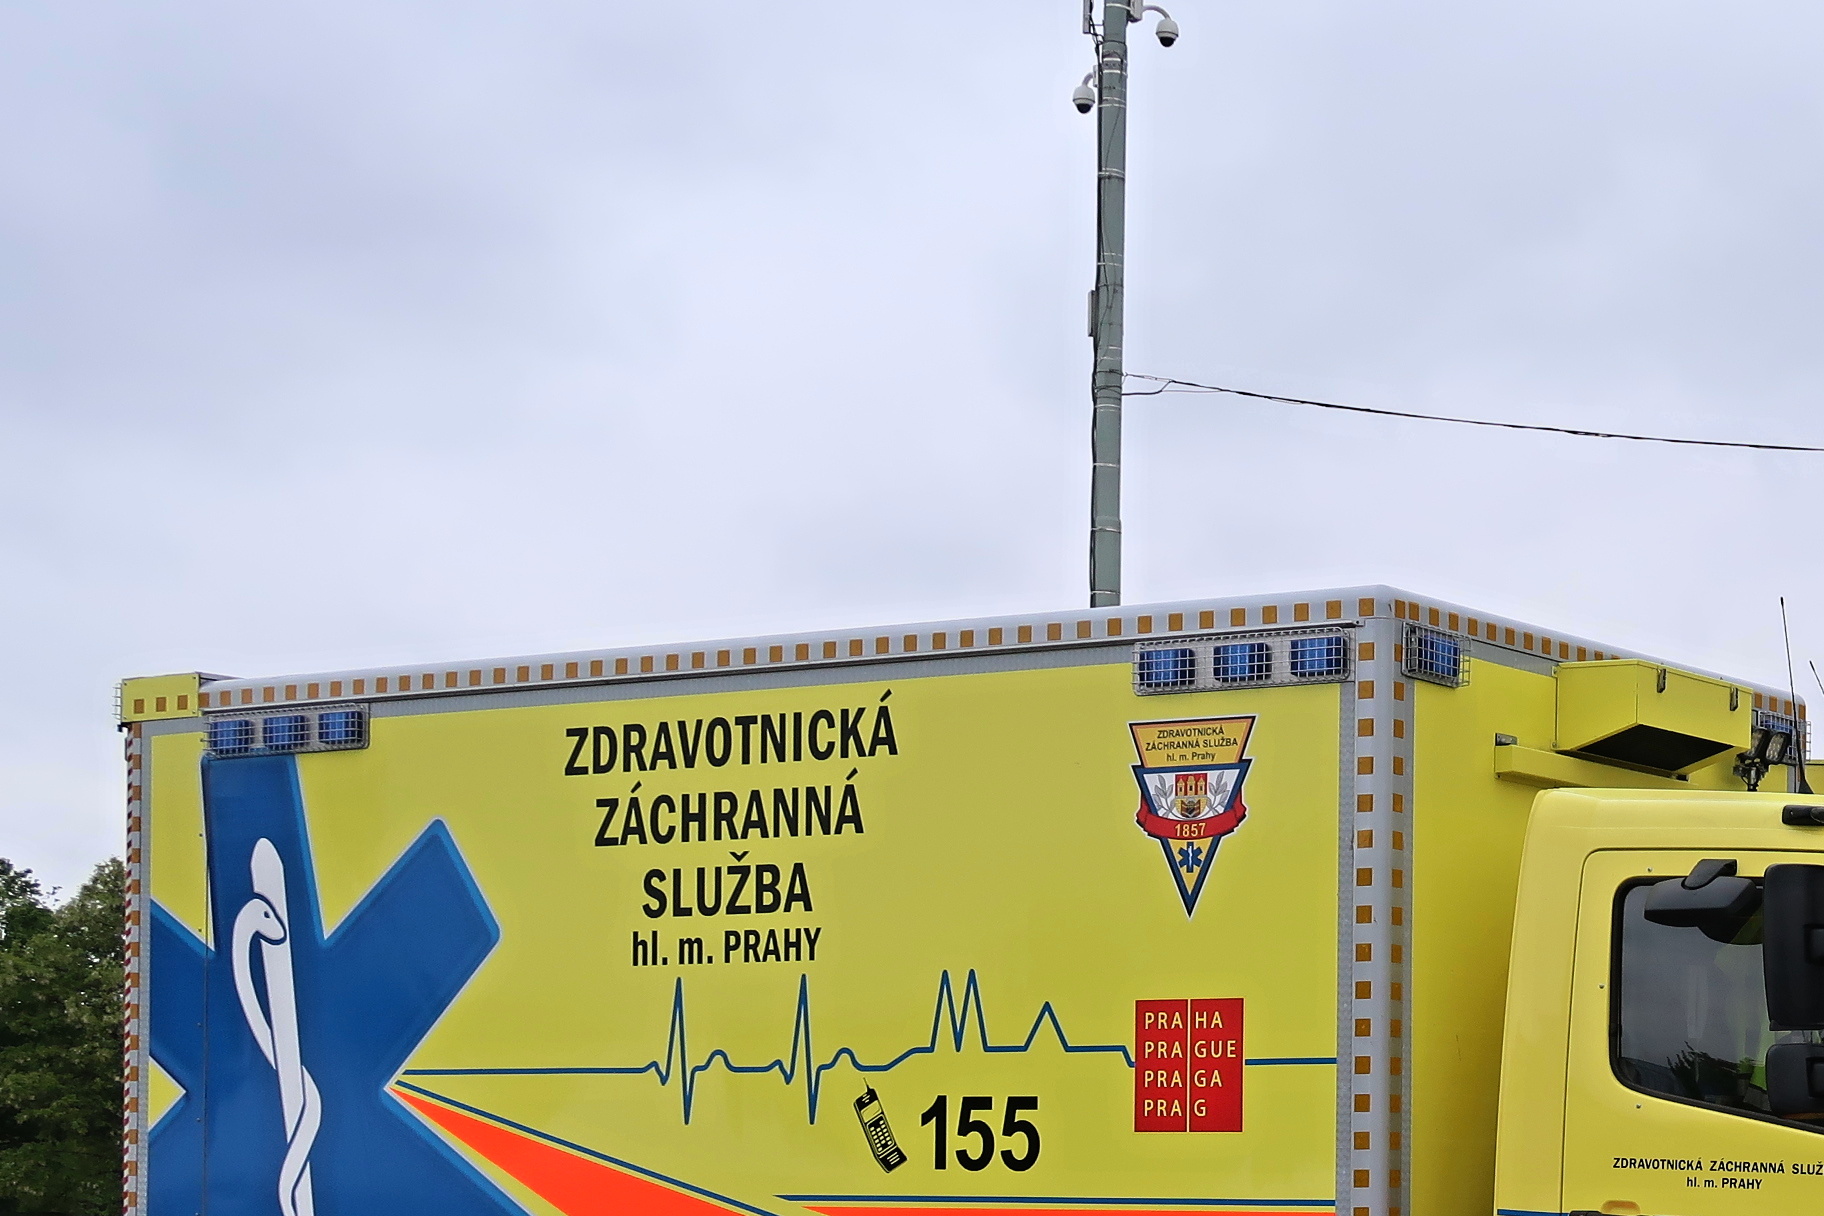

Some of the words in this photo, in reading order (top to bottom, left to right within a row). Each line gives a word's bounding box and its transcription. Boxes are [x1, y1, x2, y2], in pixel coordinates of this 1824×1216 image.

[564, 688, 898, 776] ZDRAVOTNICKÁ
[1157, 725, 1224, 739] ZDRAVOTNICKÁ
[1145, 739, 1200, 751] ZÁCHRANNÁ
[1203, 737, 1238, 748] SLUŽBA
[1191, 752, 1216, 762] Prahy
[595, 767, 864, 846] ZÁCHRANNÁ
[1174, 822, 1206, 837] 1857
[641, 850, 813, 919] SLUŽBA
[632, 930, 668, 966] hl.
[678, 936, 714, 965] m.
[724, 927, 822, 964] PRAHY
[921, 1095, 1041, 1172] 155
[1612, 1157, 1703, 1171] ZDRAVOTNICKÁ
[1709, 1158, 1785, 1174] ZÁCHRANNÁ
[1686, 1177, 1700, 1187] hl.
[1704, 1179, 1718, 1188] m.
[1721, 1178, 1762, 1190] PRAHY
